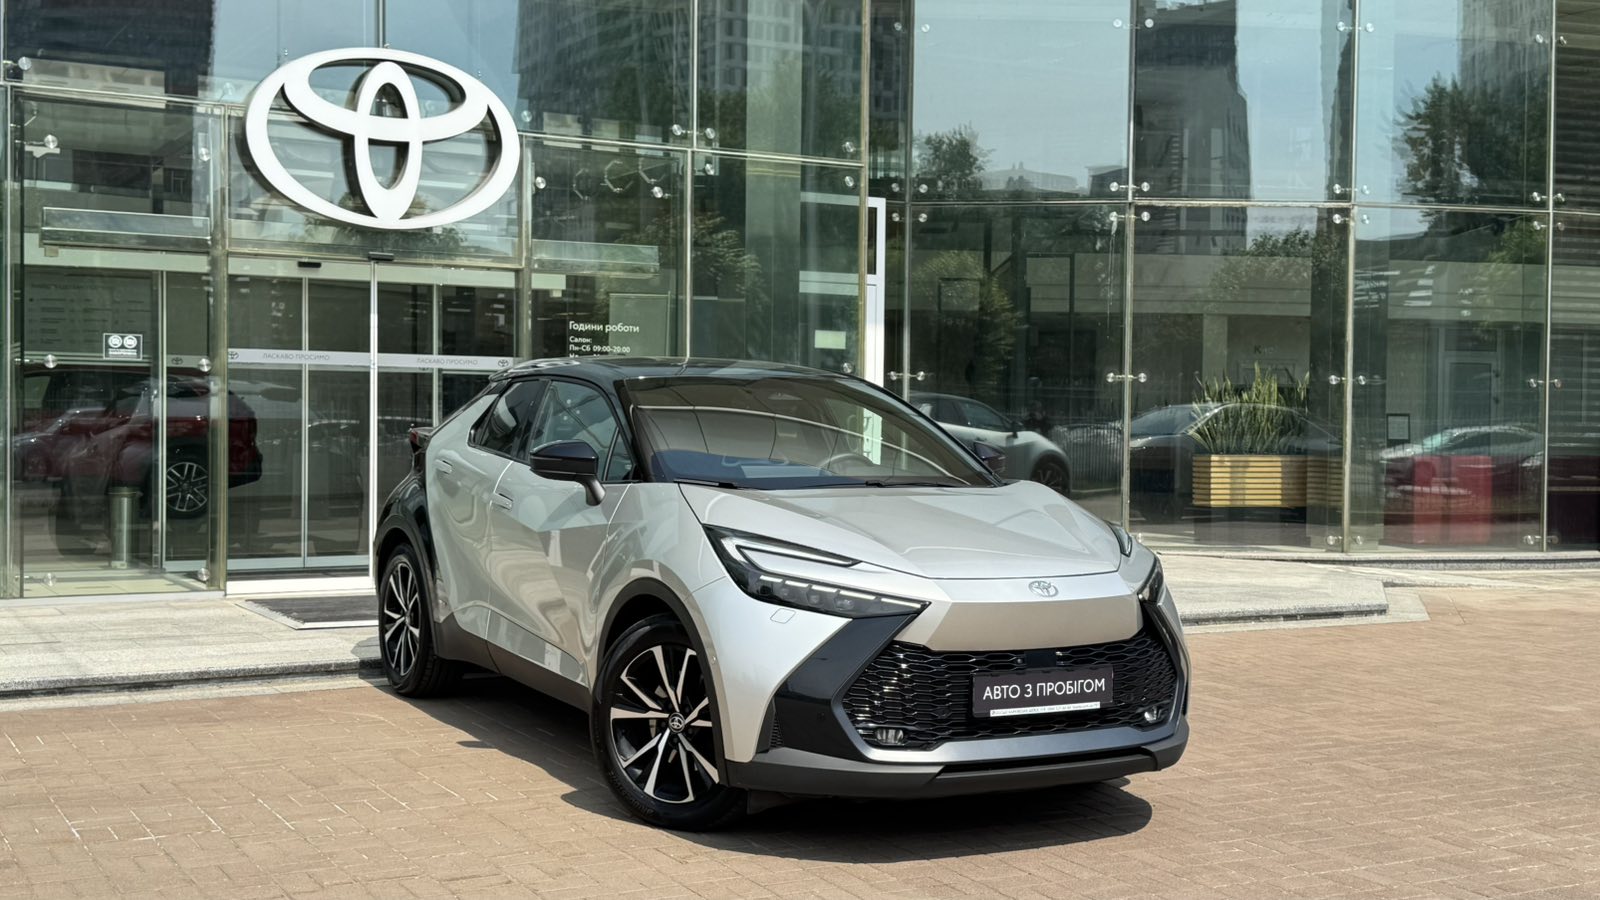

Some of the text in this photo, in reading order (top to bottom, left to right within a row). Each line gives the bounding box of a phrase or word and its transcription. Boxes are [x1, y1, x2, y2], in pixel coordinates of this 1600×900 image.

[569, 321, 640, 332] Години роботи
[983, 684, 1020, 700] АВТО
[1036, 678, 1106, 697] ПРОБІГОМ
